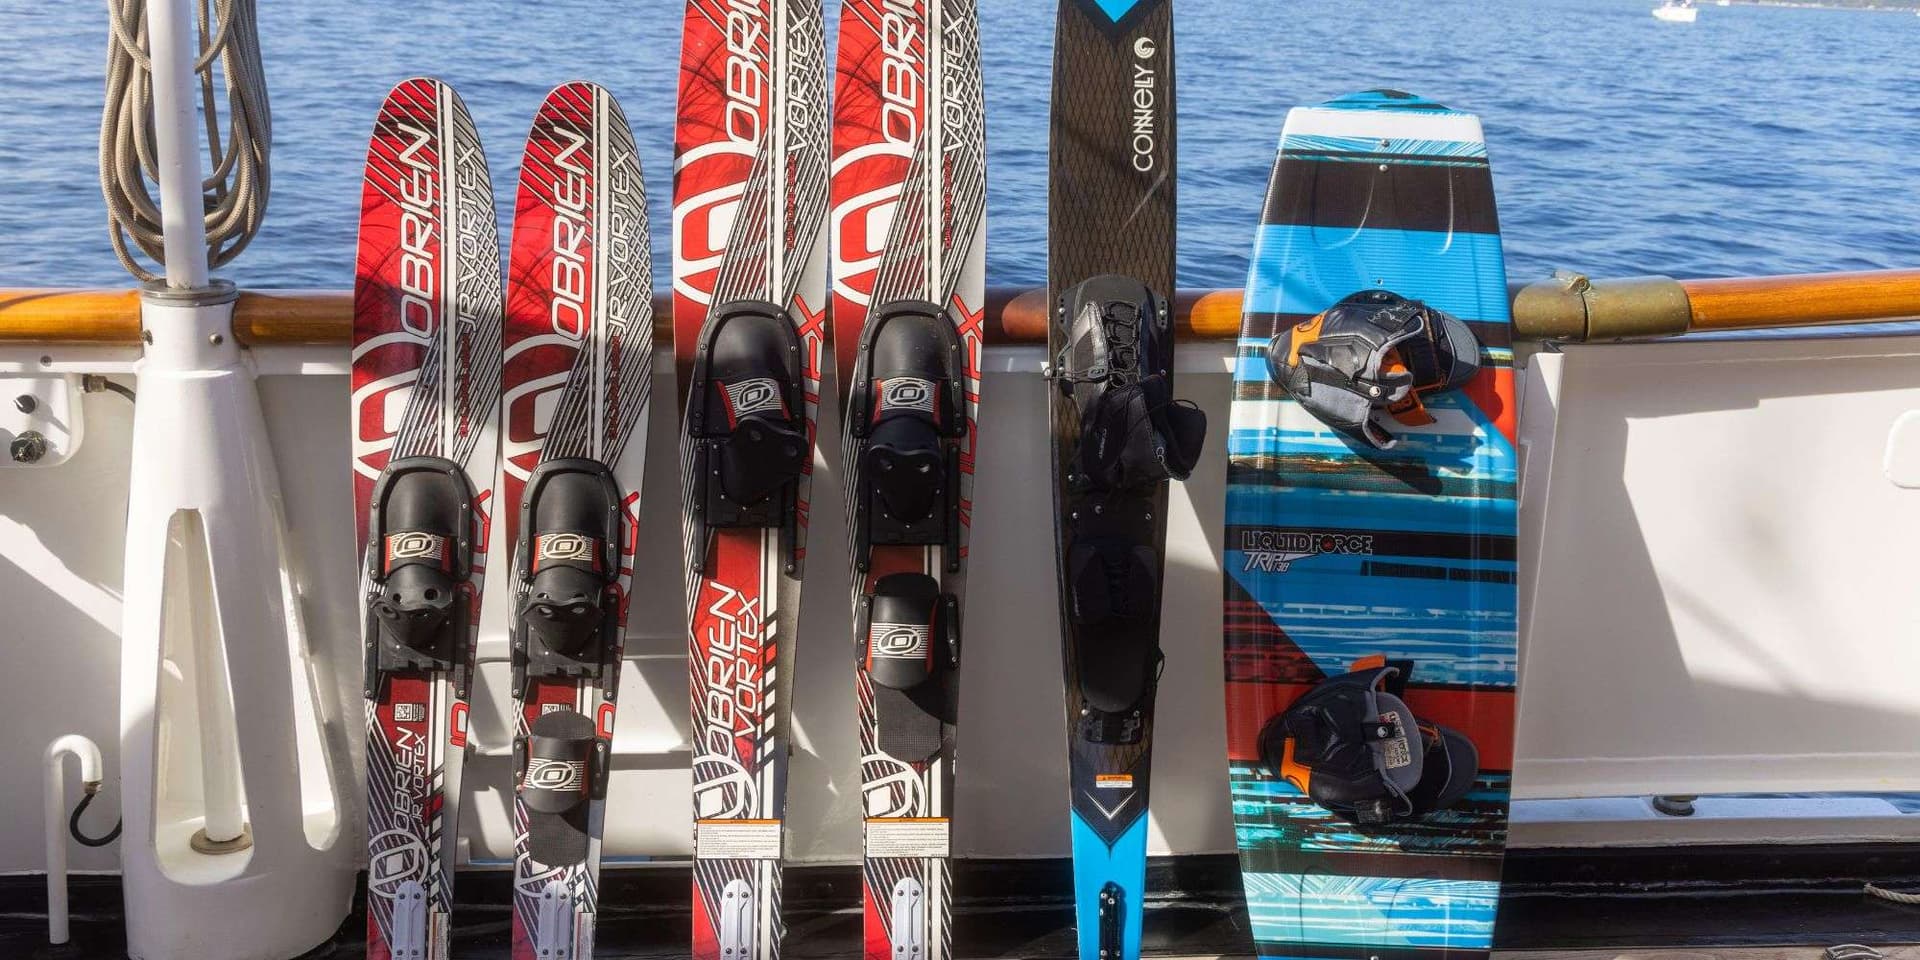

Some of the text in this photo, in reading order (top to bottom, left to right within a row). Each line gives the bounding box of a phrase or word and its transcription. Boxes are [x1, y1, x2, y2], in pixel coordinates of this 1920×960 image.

[726, 0, 762, 144] OBRI
[787, 9, 810, 151] VORTEX
[881, 0, 917, 144] OBRI
[943, 8, 964, 151] VORTEX
[399, 122, 434, 339] OBRIEN
[456, 141, 478, 283] VORTEX
[552, 126, 587, 341] OBRIEN
[610, 147, 632, 286] VORTEX
[1243, 551, 1291, 572] TRIP
[706, 581, 737, 759] OBRIEN
[735, 590, 759, 738] VORTEX
[394, 726, 413, 832] OBRIEN
[412, 732, 427, 800] VORTEX
